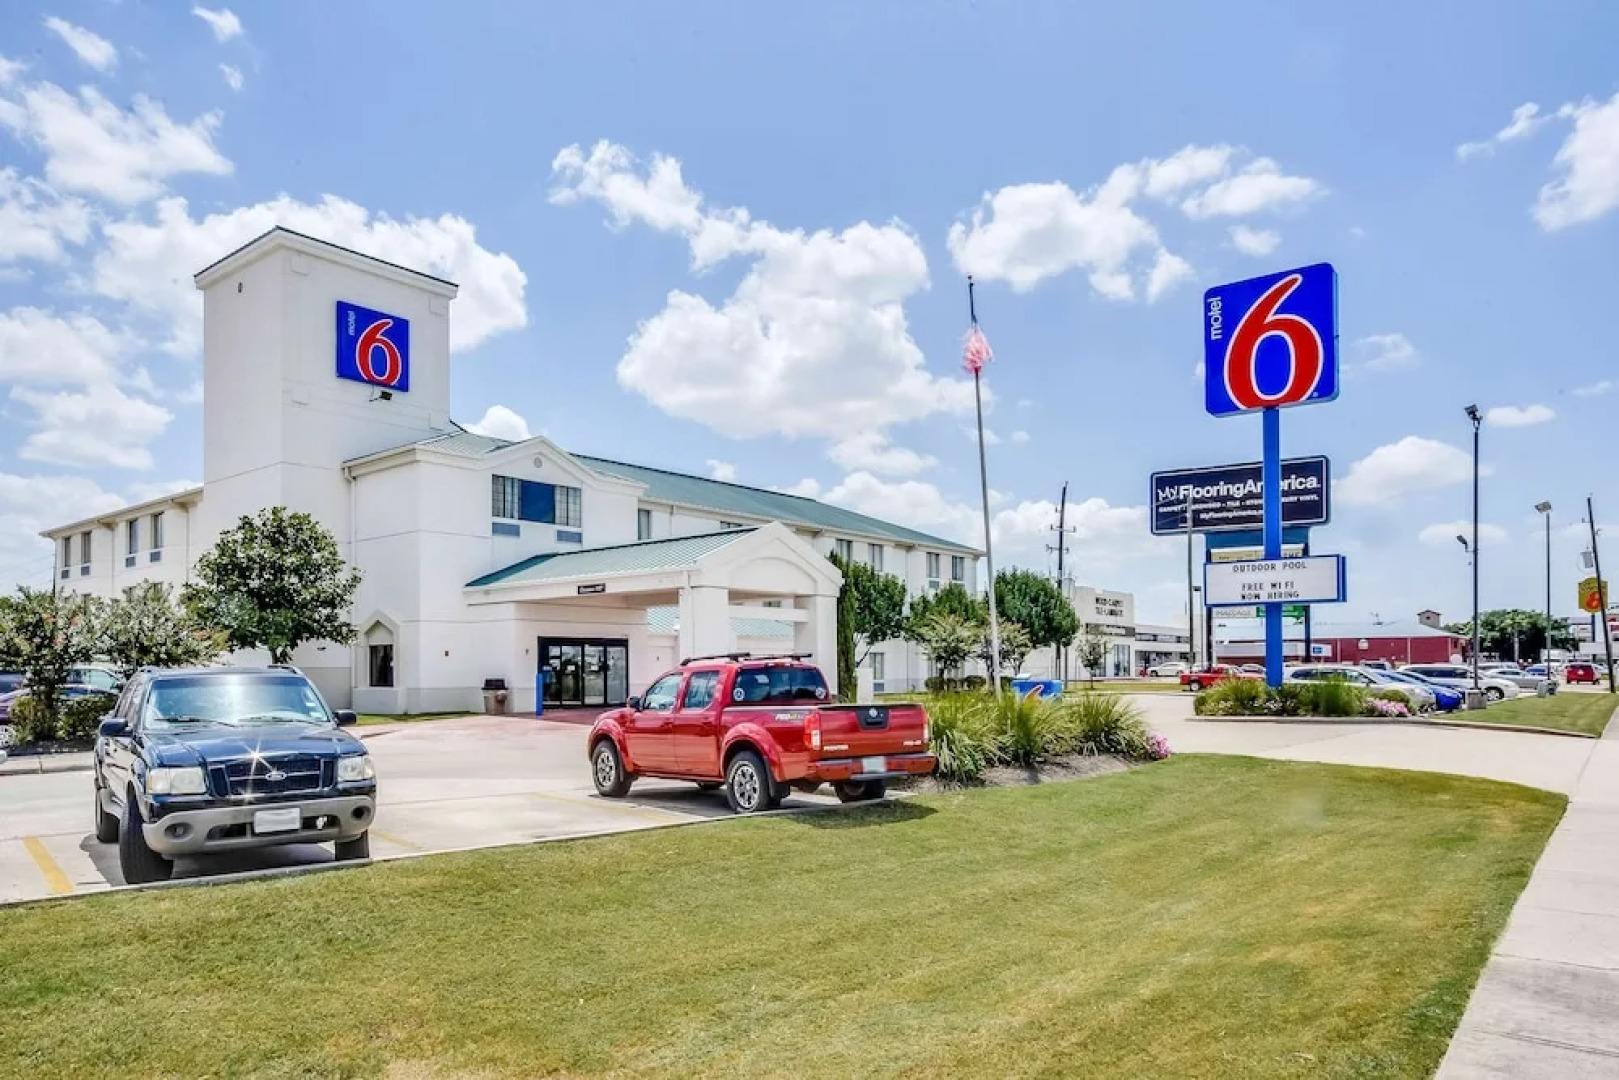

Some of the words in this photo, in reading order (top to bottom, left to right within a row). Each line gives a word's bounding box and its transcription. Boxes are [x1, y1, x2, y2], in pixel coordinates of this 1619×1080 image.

[355, 318, 402, 386] 6
[1207, 297, 1223, 341] motel
[1223, 273, 1325, 411] 6
[1232, 562, 1277, 573] OUTDOOR
[1282, 560, 1308, 570] POOL
[1241, 582, 1264, 592] FREE
